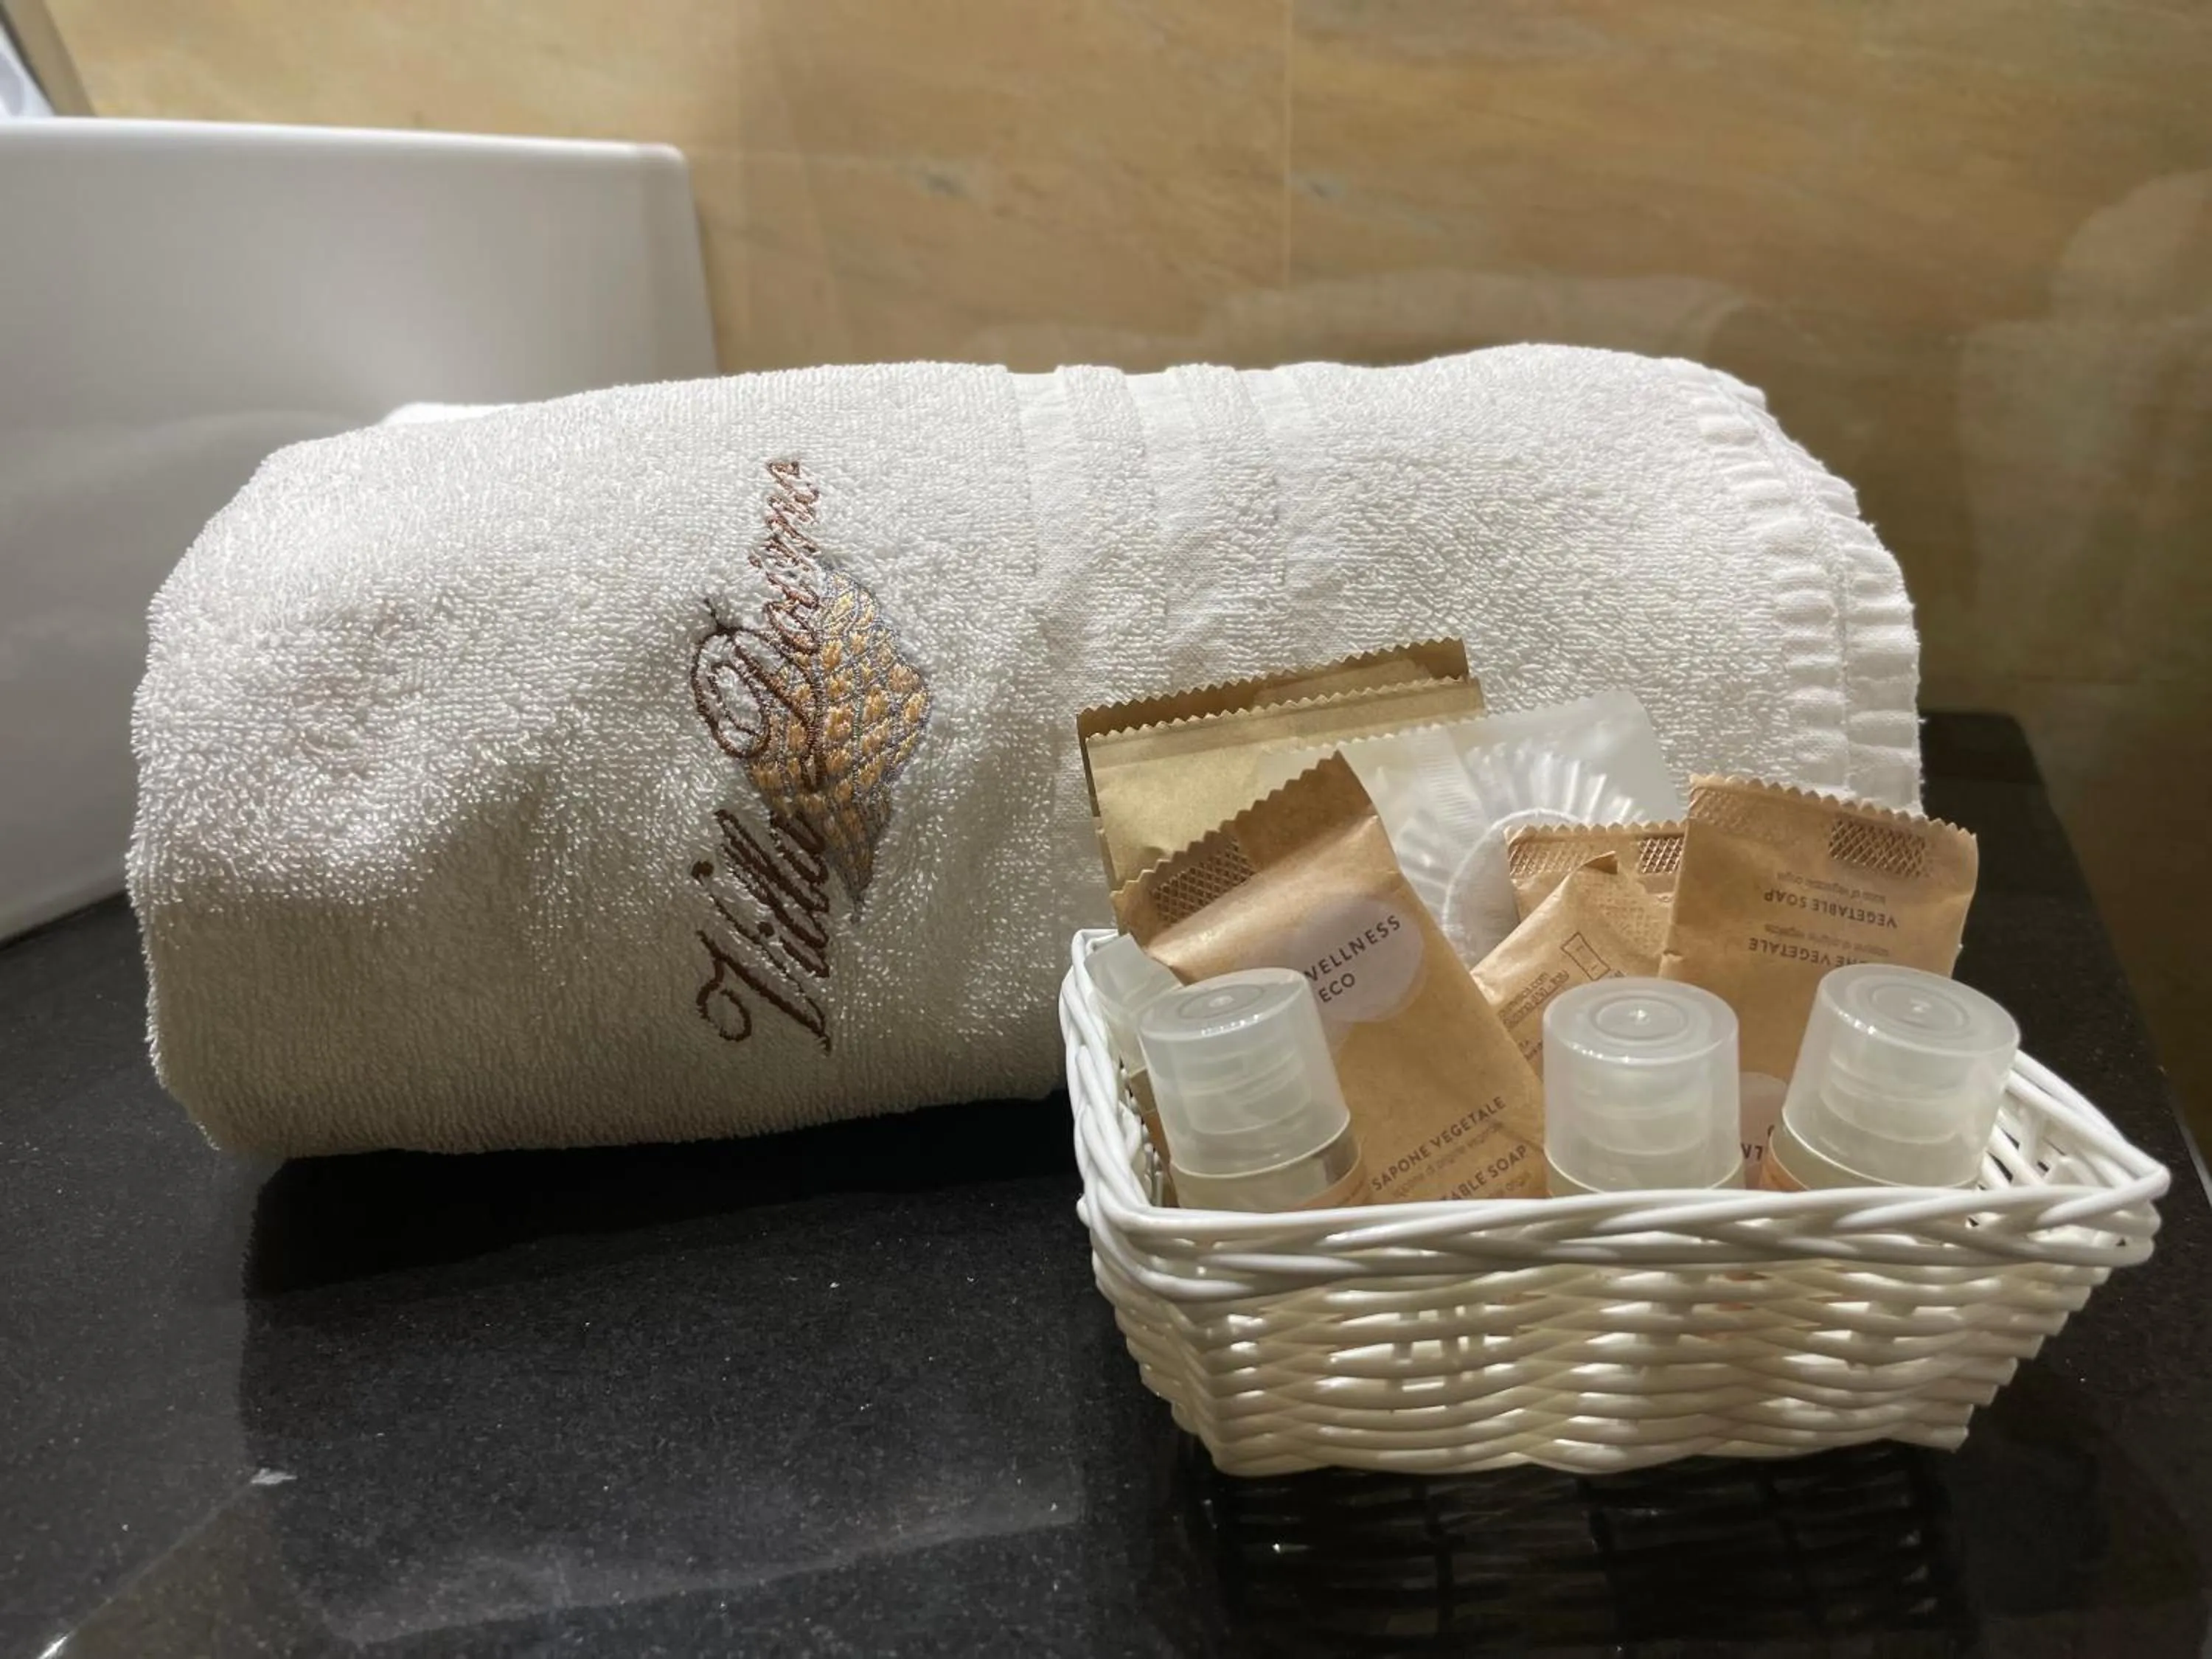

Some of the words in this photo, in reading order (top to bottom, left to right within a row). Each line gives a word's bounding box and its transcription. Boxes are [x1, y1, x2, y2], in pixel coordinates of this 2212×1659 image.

[1763, 891, 1806, 910] SOAP
[1812, 899, 1898, 928] VEGETABLE
[692, 808, 832, 1057] Villa
[1747, 937, 1833, 965] VEGETALE
[1318, 973, 1355, 1002] ECO
[1371, 1145, 1430, 1191] SAPONE
[1430, 1096, 1506, 1148] VEGETALE
[1487, 1144, 1527, 1178] SOAP
